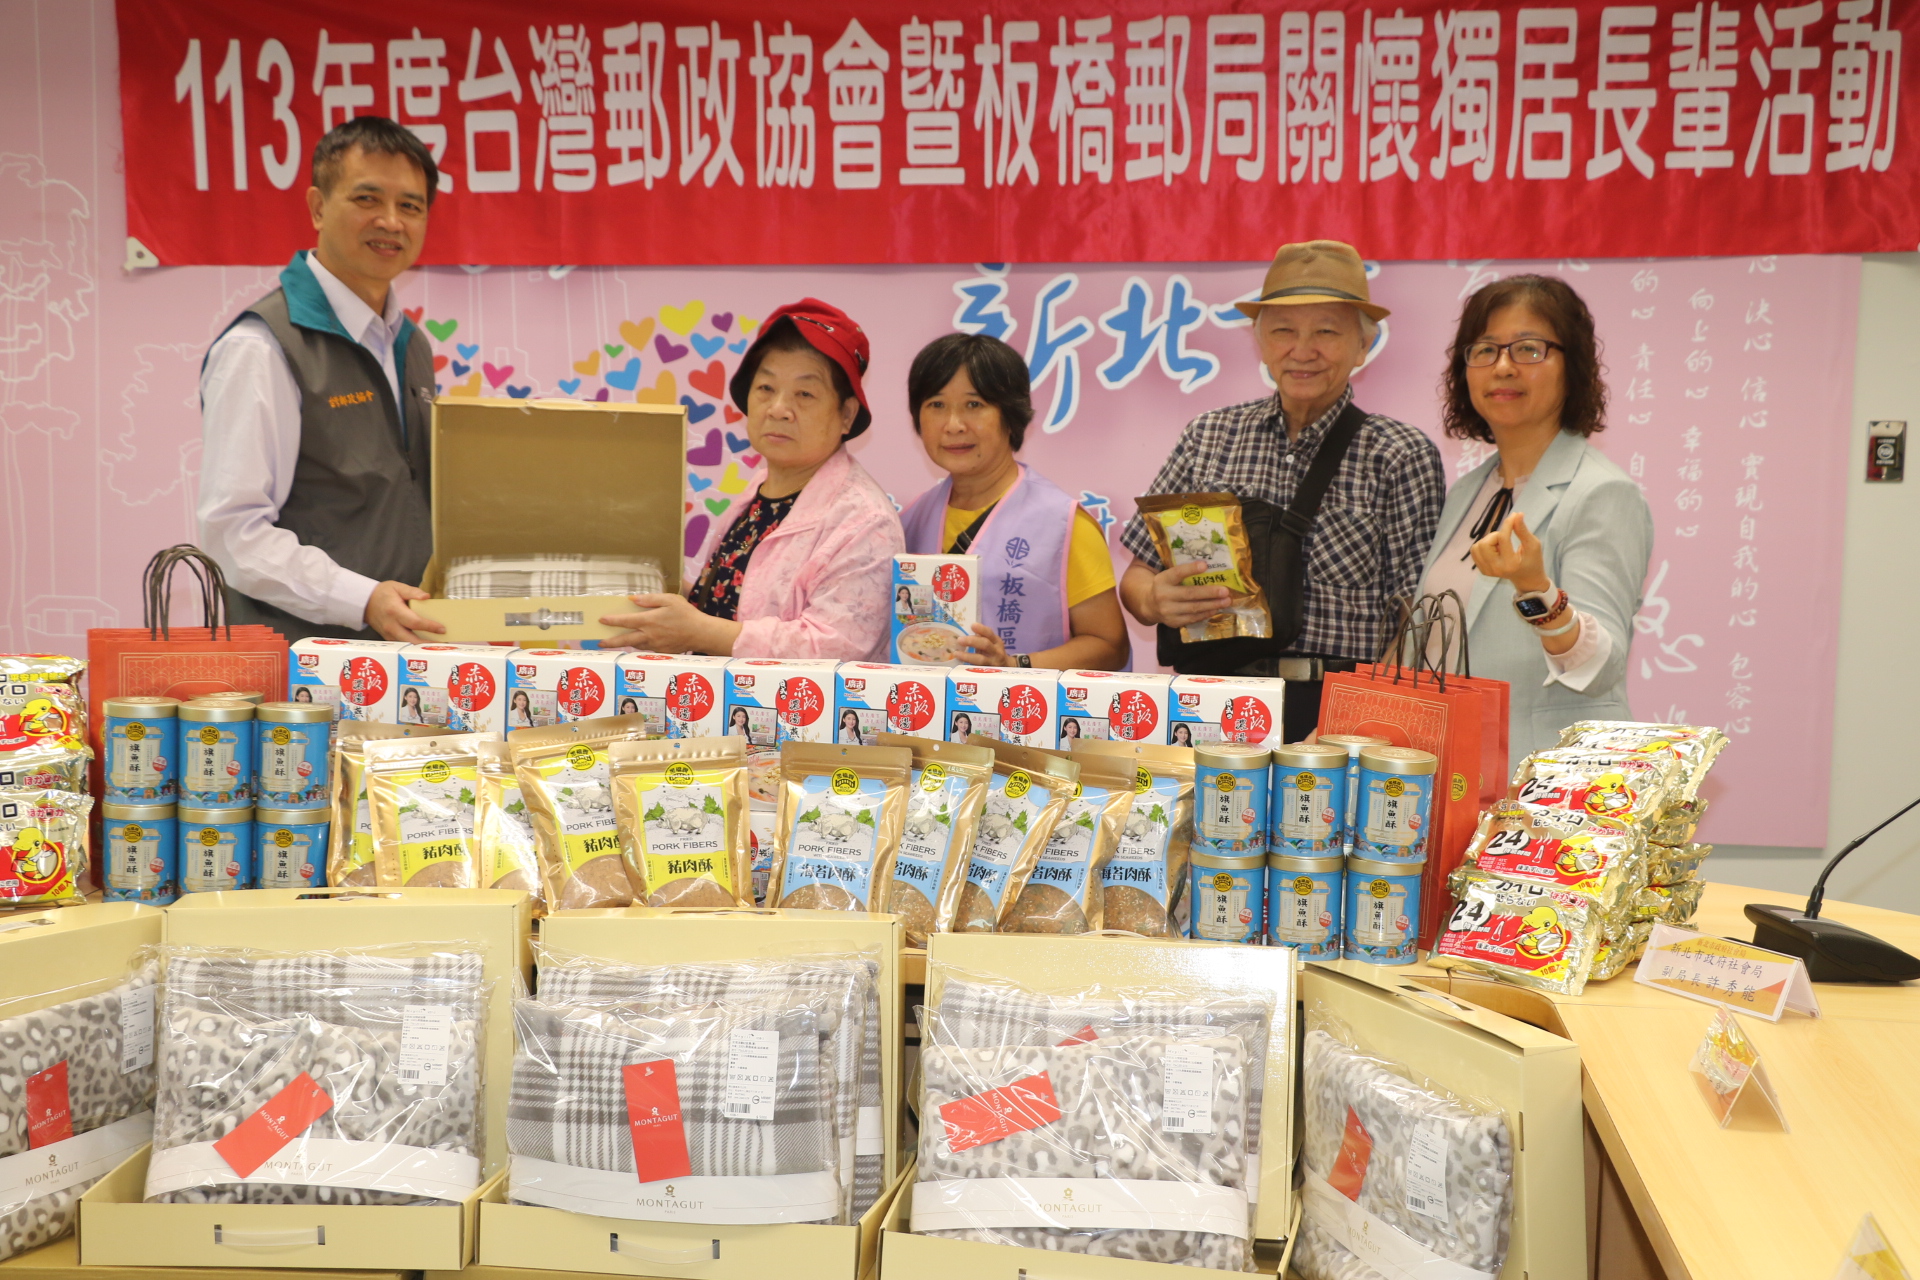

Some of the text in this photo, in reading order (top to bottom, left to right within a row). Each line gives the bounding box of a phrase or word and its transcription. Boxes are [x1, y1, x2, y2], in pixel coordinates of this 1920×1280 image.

[1744, 297, 1774, 352] 決心
[1684, 287, 1714, 400] 向上的心
[1626, 342, 1655, 425] 責任心
[1739, 376, 1769, 429] 信心
[1674, 425, 1703, 538] 幸福的心
[1729, 452, 1764, 627] 實現自我的心
[997, 572, 1027, 650] 板橋區
[358, 659, 383, 690] 赤阪
[466, 664, 490, 696] 赤阪
[575, 669, 600, 701] 赤阪
[684, 674, 708, 706] 赤阪
[794, 679, 818, 711] 赤阪
[904, 683, 929, 715] 赤阪
[1017, 687, 1042, 719] 赤阪
[1723, 652, 1754, 735] 包容心
[1128, 692, 1152, 724] 赤阪
[1240, 698, 1266, 730] 赤阪
[129, 744, 141, 773] 旗魚酥
[204, 747, 215, 776] 旗魚酥
[274, 747, 286, 777] 旗魚酥
[1218, 794, 1230, 824] 旗魚酥
[1298, 794, 1310, 824] 旗魚酥
[1385, 799, 1398, 829] 旗魚酥
[407, 827, 474, 840] PORK FIBERS
[566, 818, 616, 832] PORK FIBE
[1488, 830, 1524, 848] 24
[126, 845, 138, 874] 旗魚酥
[652, 840, 718, 851] PORK FIBERS
[798, 844, 862, 856] PORK FIBERS
[906, 844, 936, 856] FIBERS
[980, 846, 1008, 860] FIBERS
[1045, 848, 1080, 857] FIBERS
[1122, 848, 1156, 856] FIBERS
[203, 848, 215, 878] 旗魚酥
[277, 850, 288, 880] 旗魚酥
[668, 858, 714, 874] 豬肉酥
[800, 863, 856, 882] 海苔肉酥
[894, 861, 930, 881] 苔肉酥
[1032, 866, 1072, 882] 苔肉酥
[1496, 880, 1544, 896] カイロ
[1216, 894, 1228, 924] 旗魚酥
[1296, 898, 1308, 928] 旗魚酥
[1452, 900, 1484, 924] 24
[1670, 942, 1763, 978] 新北市政府社會局
[1662, 966, 1756, 1002] 副局長許秀能
[31, 1108, 68, 1132] MONTAGUT
[260, 1108, 290, 1142] MONTAGUT
[634, 1113, 678, 1128] MONTAGUT
[991, 1092, 1010, 1134] MONTAGUT
[25, 1160, 80, 1186] MONTAGUT
[264, 1160, 334, 1173] MONTAGUT
[636, 1198, 704, 1210] MONTAGUT
